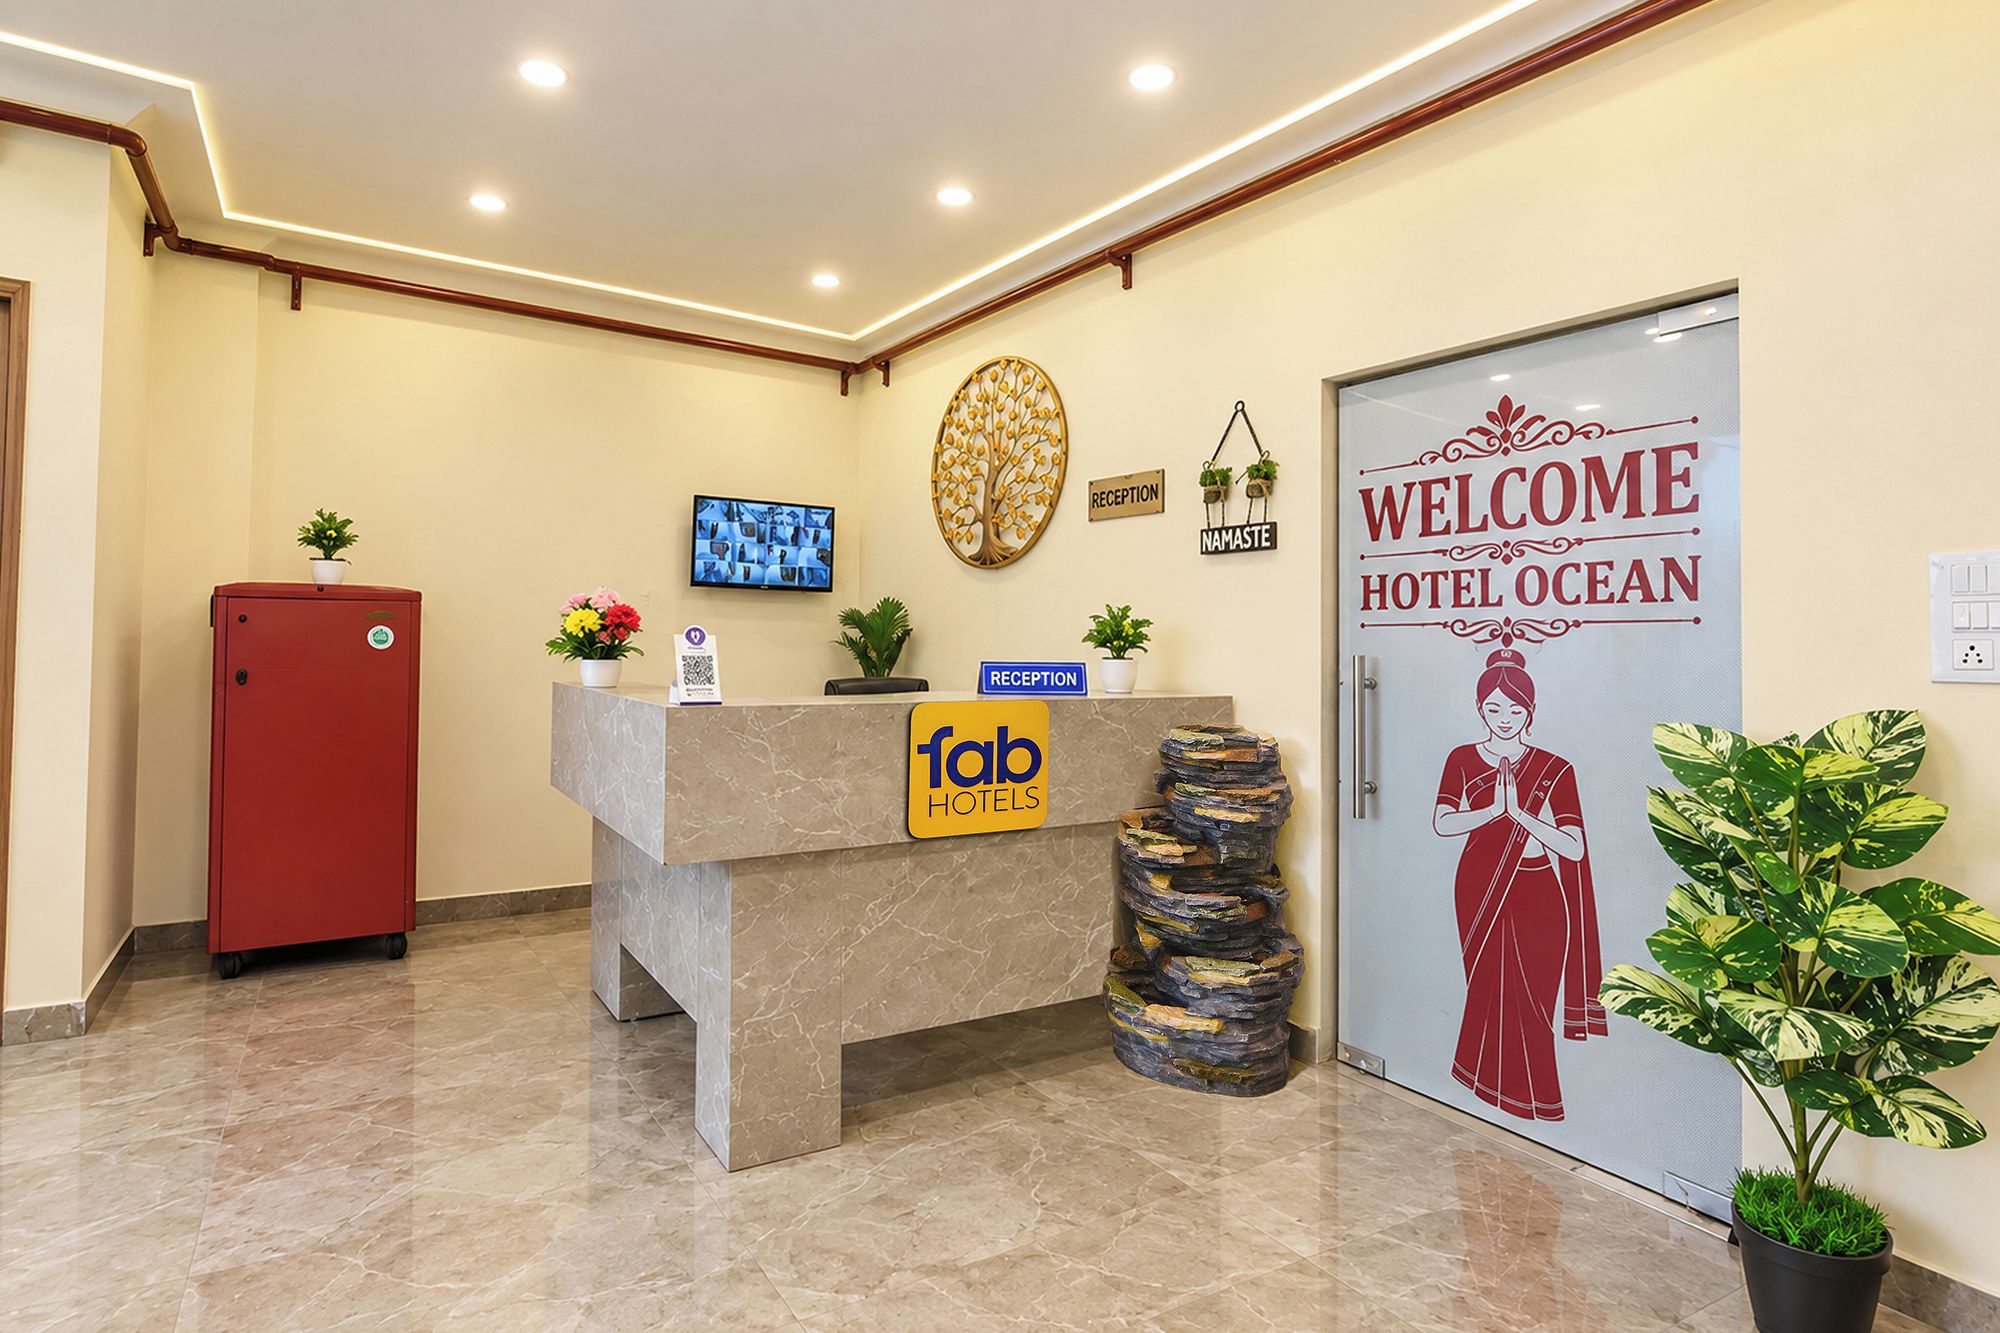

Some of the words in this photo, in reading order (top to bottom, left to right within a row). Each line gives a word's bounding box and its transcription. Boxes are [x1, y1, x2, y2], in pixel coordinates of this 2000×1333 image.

[1092, 484, 1159, 508] RECEPTION
[1358, 441, 1700, 542] WELCOME
[1202, 525, 1271, 552] NAMASTE
[1360, 567, 1504, 612] HOTEL
[1514, 554, 1702, 606] OCEAN
[991, 671, 1077, 686] RECEPTION
[917, 725, 1042, 788] fab
[928, 786, 1040, 817] HOTELS
